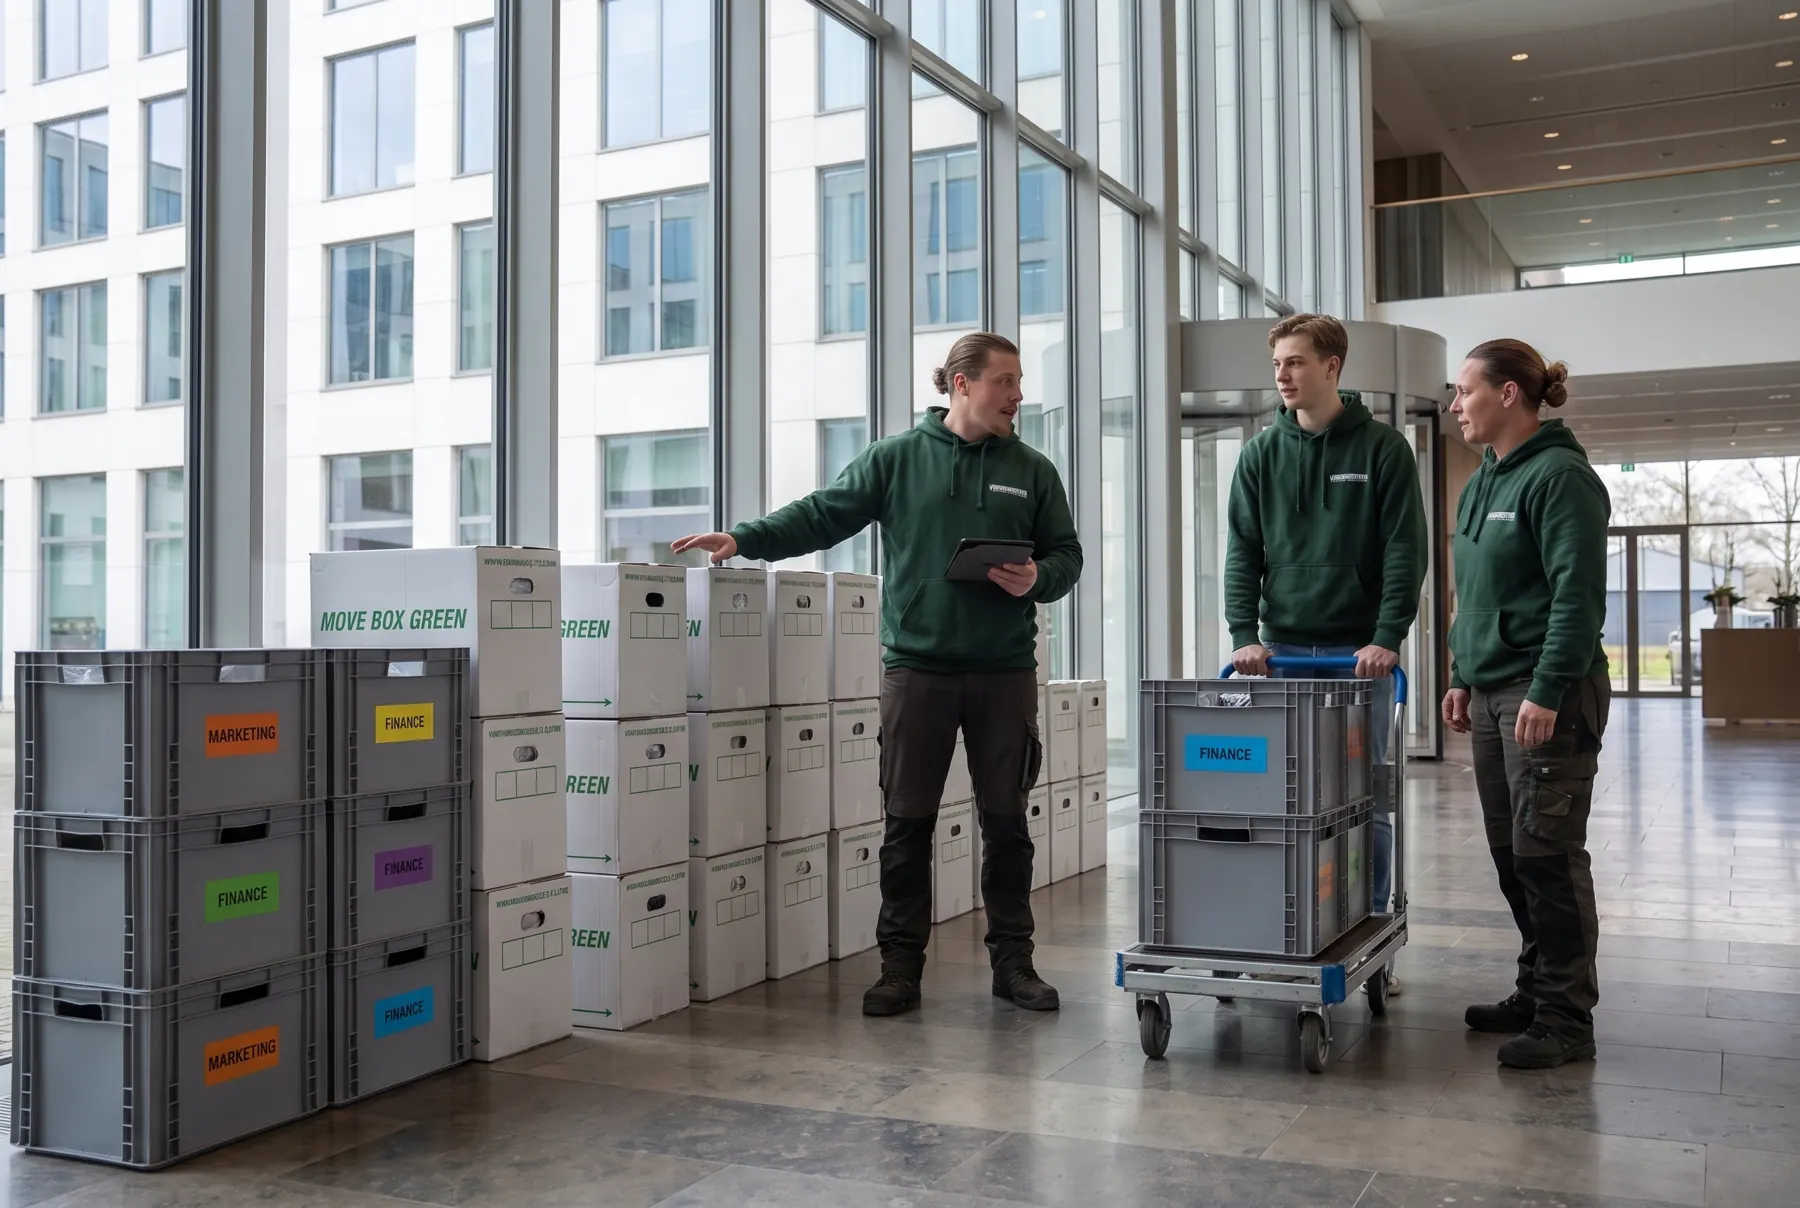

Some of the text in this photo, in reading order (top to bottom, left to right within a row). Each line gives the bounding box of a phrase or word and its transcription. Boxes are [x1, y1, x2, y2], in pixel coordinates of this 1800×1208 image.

[320, 608, 467, 631] MOVE BOX GREEN
[385, 715, 424, 730] FINANCE
[208, 726, 276, 744] MARKETING
[1199, 747, 1252, 761] FINANCE
[566, 775, 610, 794] REEN
[384, 857, 424, 876] FINANCE
[218, 886, 268, 908] FINANCE
[572, 928, 610, 949] REEN
[384, 1000, 424, 1022] FINANCE
[208, 1039, 276, 1072] MARKETING
